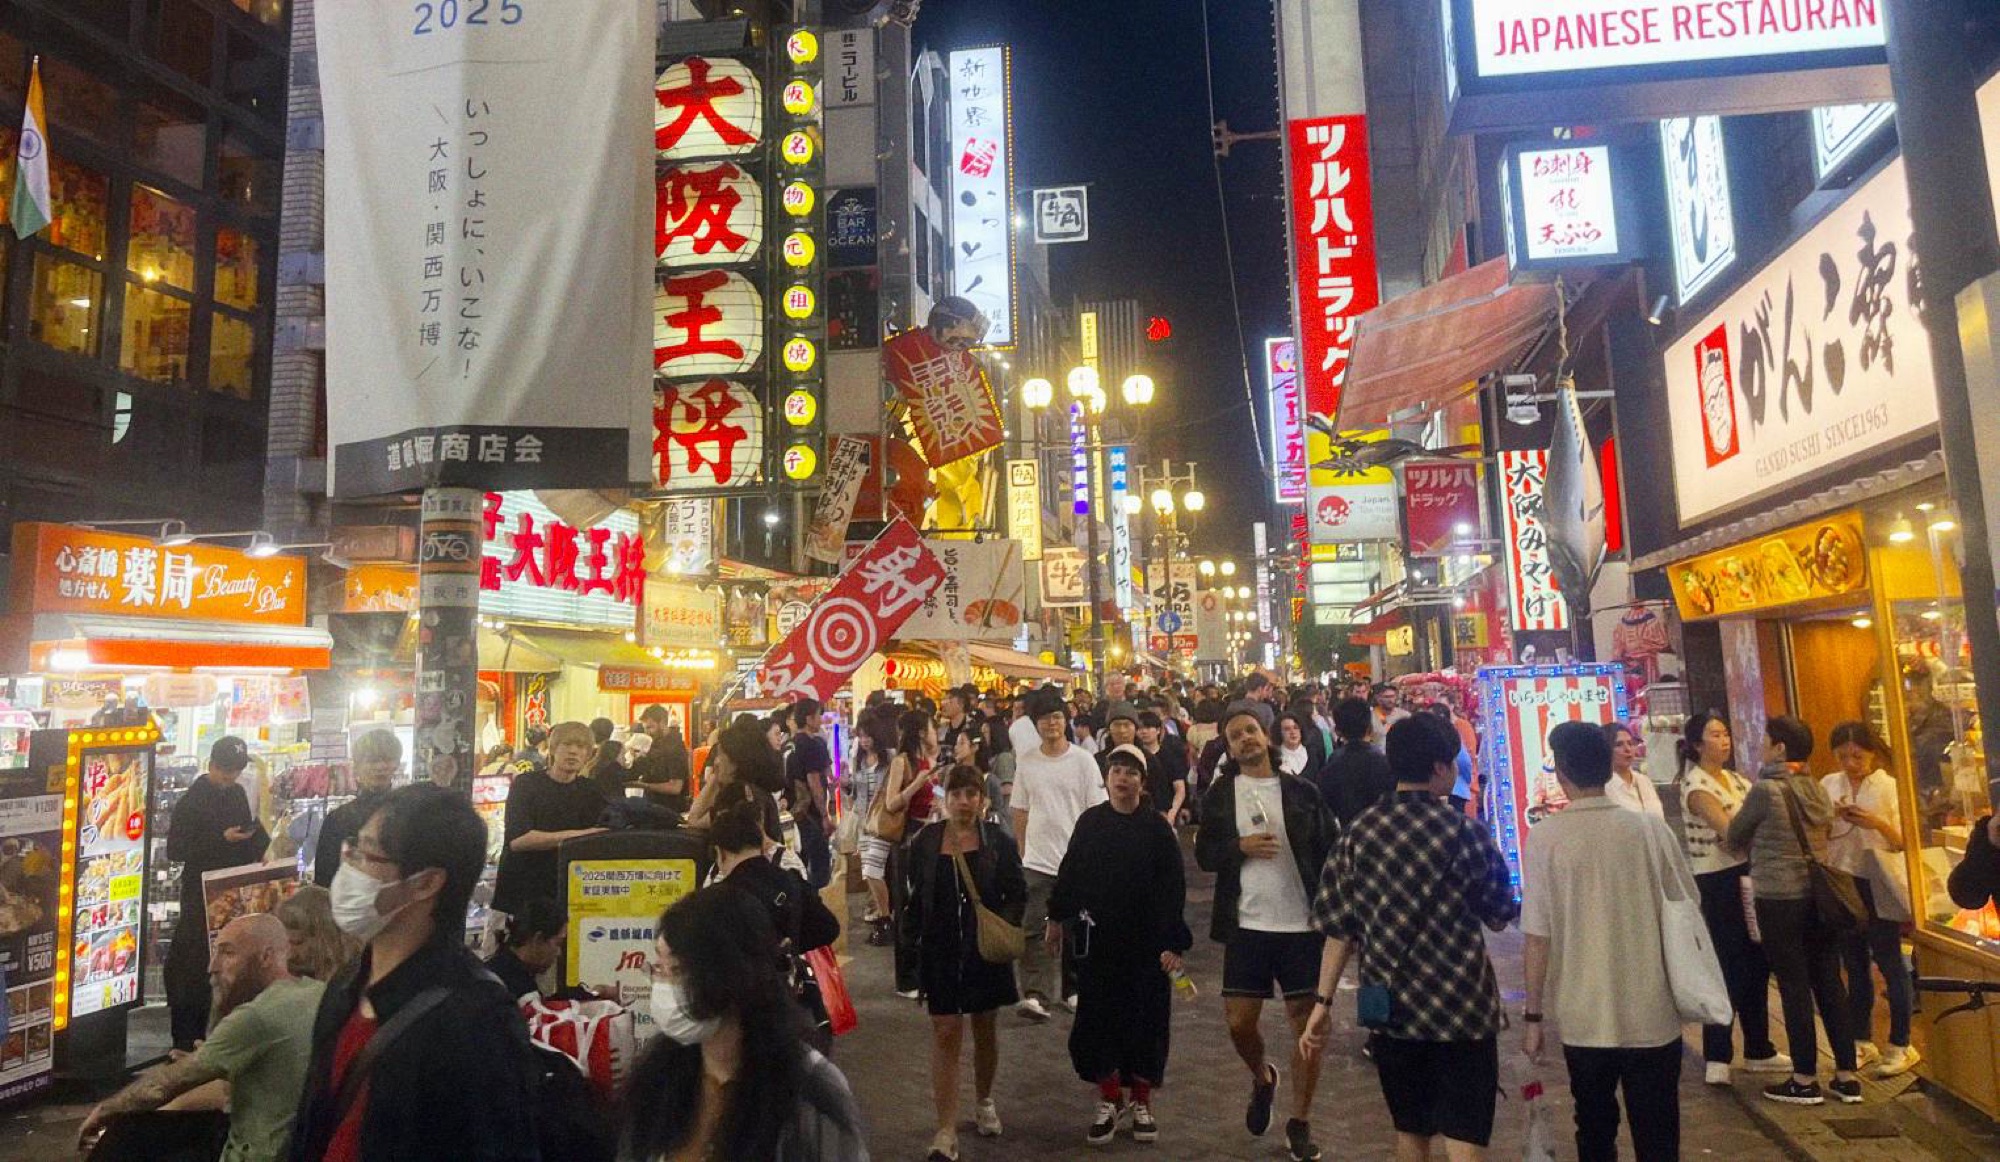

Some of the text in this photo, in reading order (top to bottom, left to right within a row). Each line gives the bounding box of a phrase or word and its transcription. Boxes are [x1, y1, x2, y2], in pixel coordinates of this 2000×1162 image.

[413, 0, 523, 35] 2025
[1494, 16, 1661, 56] JAPANESE
[1533, 151, 1594, 177] お刺身
[838, 217, 866, 229] BAR
[1044, 201, 1081, 229] 牛角
[419, 136, 449, 347] 大阪・関西万博
[458, 98, 490, 378] いっしょに、いこな！
[827, 234, 876, 247] OCEAN
[654, 55, 758, 486] 大阪王将
[1789, 431, 1821, 465] SUSHI
[1408, 467, 1476, 488] ツルハ
[1409, 492, 1464, 507] ドラッグ
[681, 500, 696, 534] フェ
[55, 545, 118, 578] 心斎橋
[504, 513, 646, 607] 大阪王将
[121, 547, 195, 610] 薬局
[196, 563, 287, 614] Beauty Plus
[1154, 604, 1192, 613] KRA
[1510, 686, 1608, 704] いらっしゃいませ
